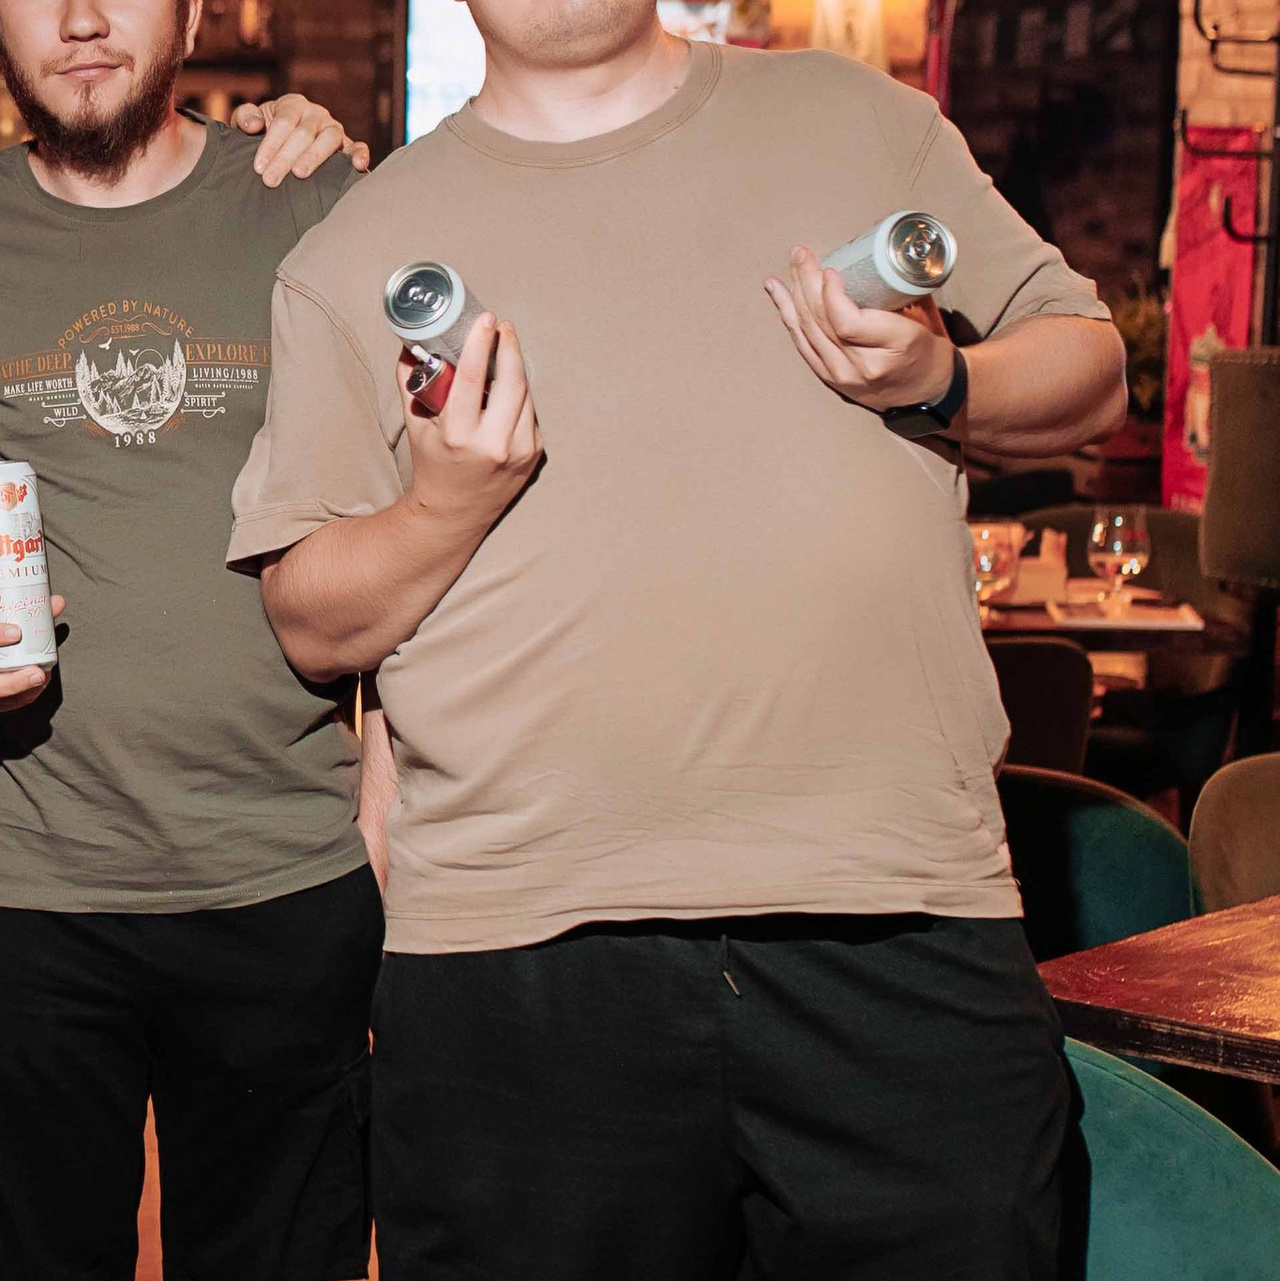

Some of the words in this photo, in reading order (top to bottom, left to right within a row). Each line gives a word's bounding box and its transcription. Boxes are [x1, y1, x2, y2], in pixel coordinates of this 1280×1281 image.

[58, 302, 117, 349] POWERED
[122, 299, 138, 313] BY
[143, 301, 196, 339] NATURE
[185, 342, 259, 363] EXPLORE
[3, 384, 25, 396] MAKE
[27, 381, 43, 392] LIFE
[44, 377, 73, 389] WORTH
[192, 367, 259, 380] LIVING/1988
[53, 406, 79, 418] WILD
[184, 397, 218, 407] SPIRIT
[114, 431, 157, 448] 1988
